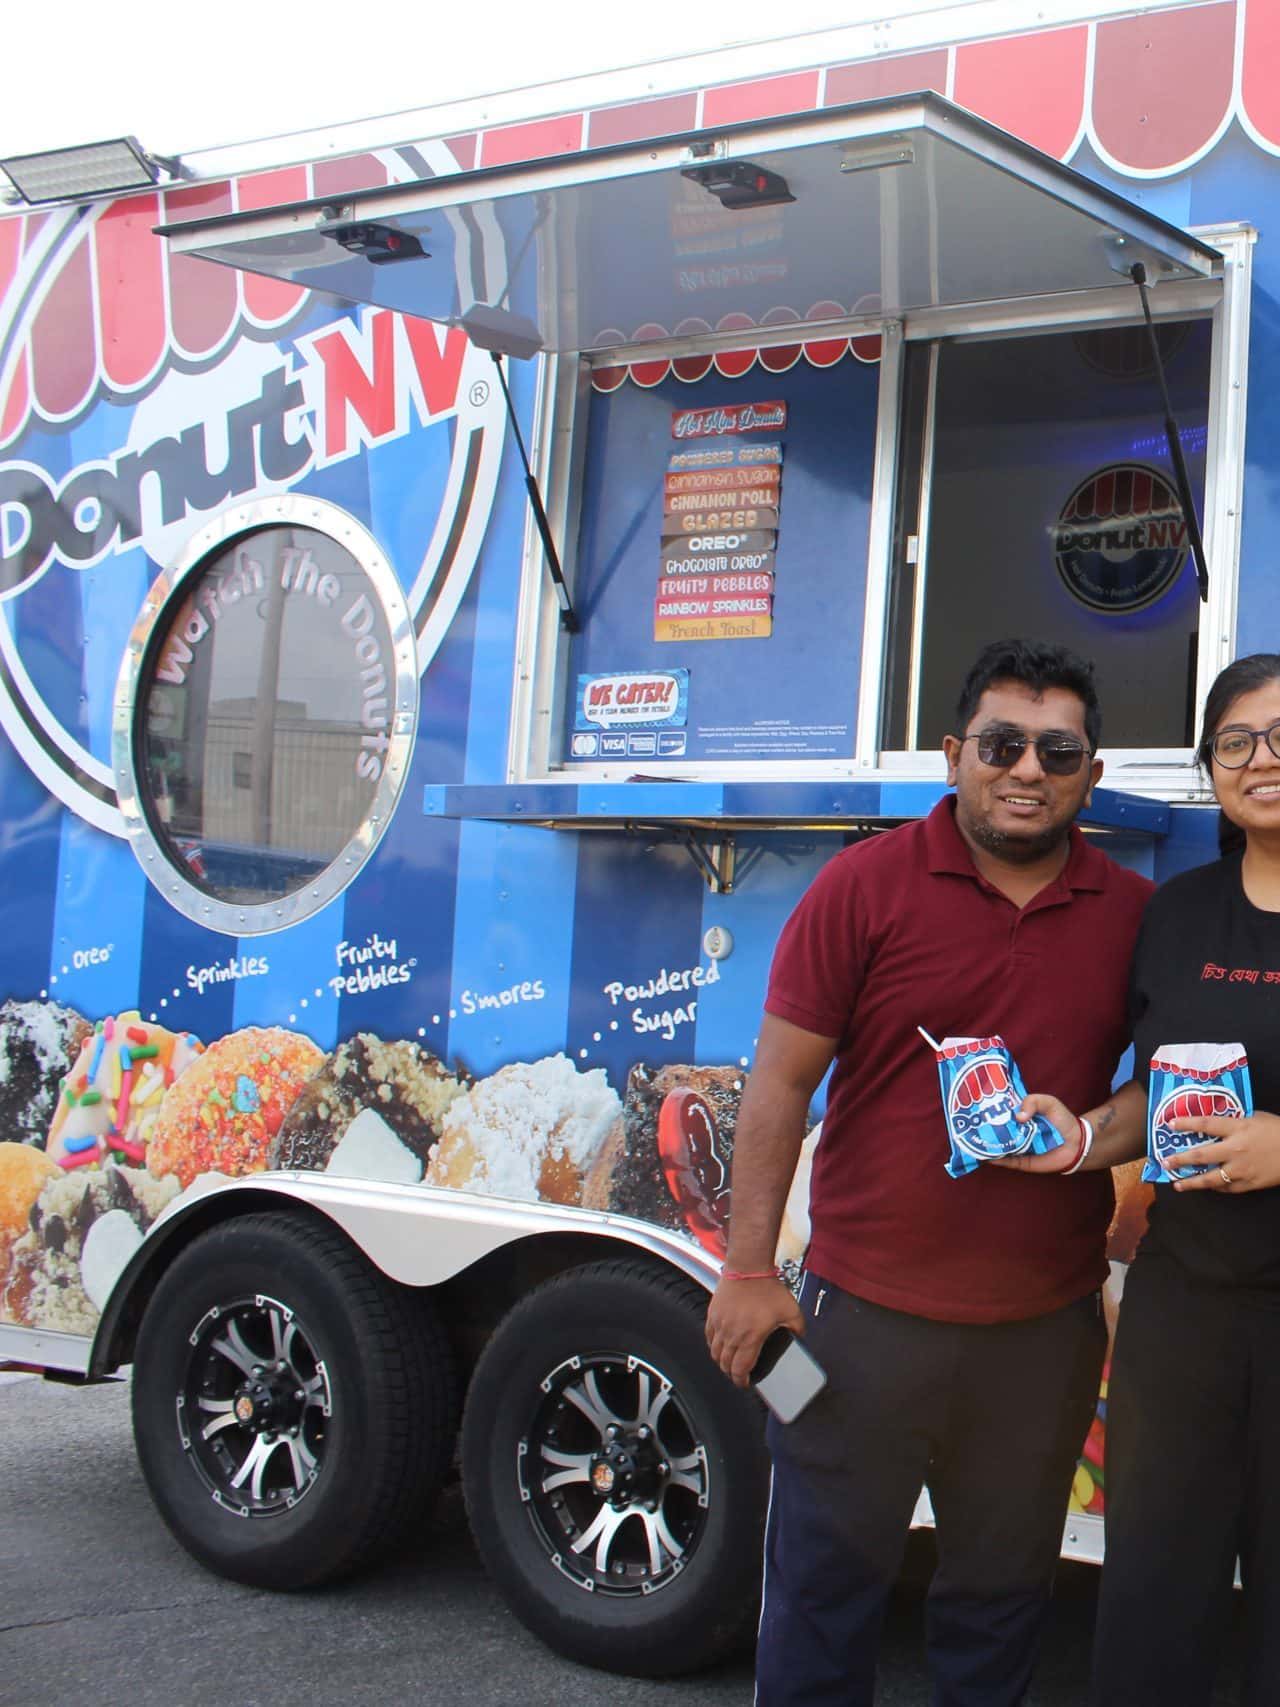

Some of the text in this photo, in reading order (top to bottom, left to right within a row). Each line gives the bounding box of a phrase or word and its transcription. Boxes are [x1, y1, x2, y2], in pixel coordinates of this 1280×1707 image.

[675, 413, 702, 437] Hot
[739, 406, 785, 431] Donuts
[682, 510, 758, 531] GLAZED
[659, 598, 768, 616] RAINBOW SPRINKLES
[669, 619, 756, 638] French Toast
[281, 546, 341, 606] The
[341, 593, 391, 782] Donuts
[589, 680, 675, 706] WE CATER!
[603, 739, 625, 750] VISA
[336, 933, 397, 967] Fruity
[186, 957, 270, 995] Sprinkles
[604, 958, 721, 1005] Powdered
[460, 980, 545, 1014] S'mores
[632, 1002, 698, 1041] Sugar
